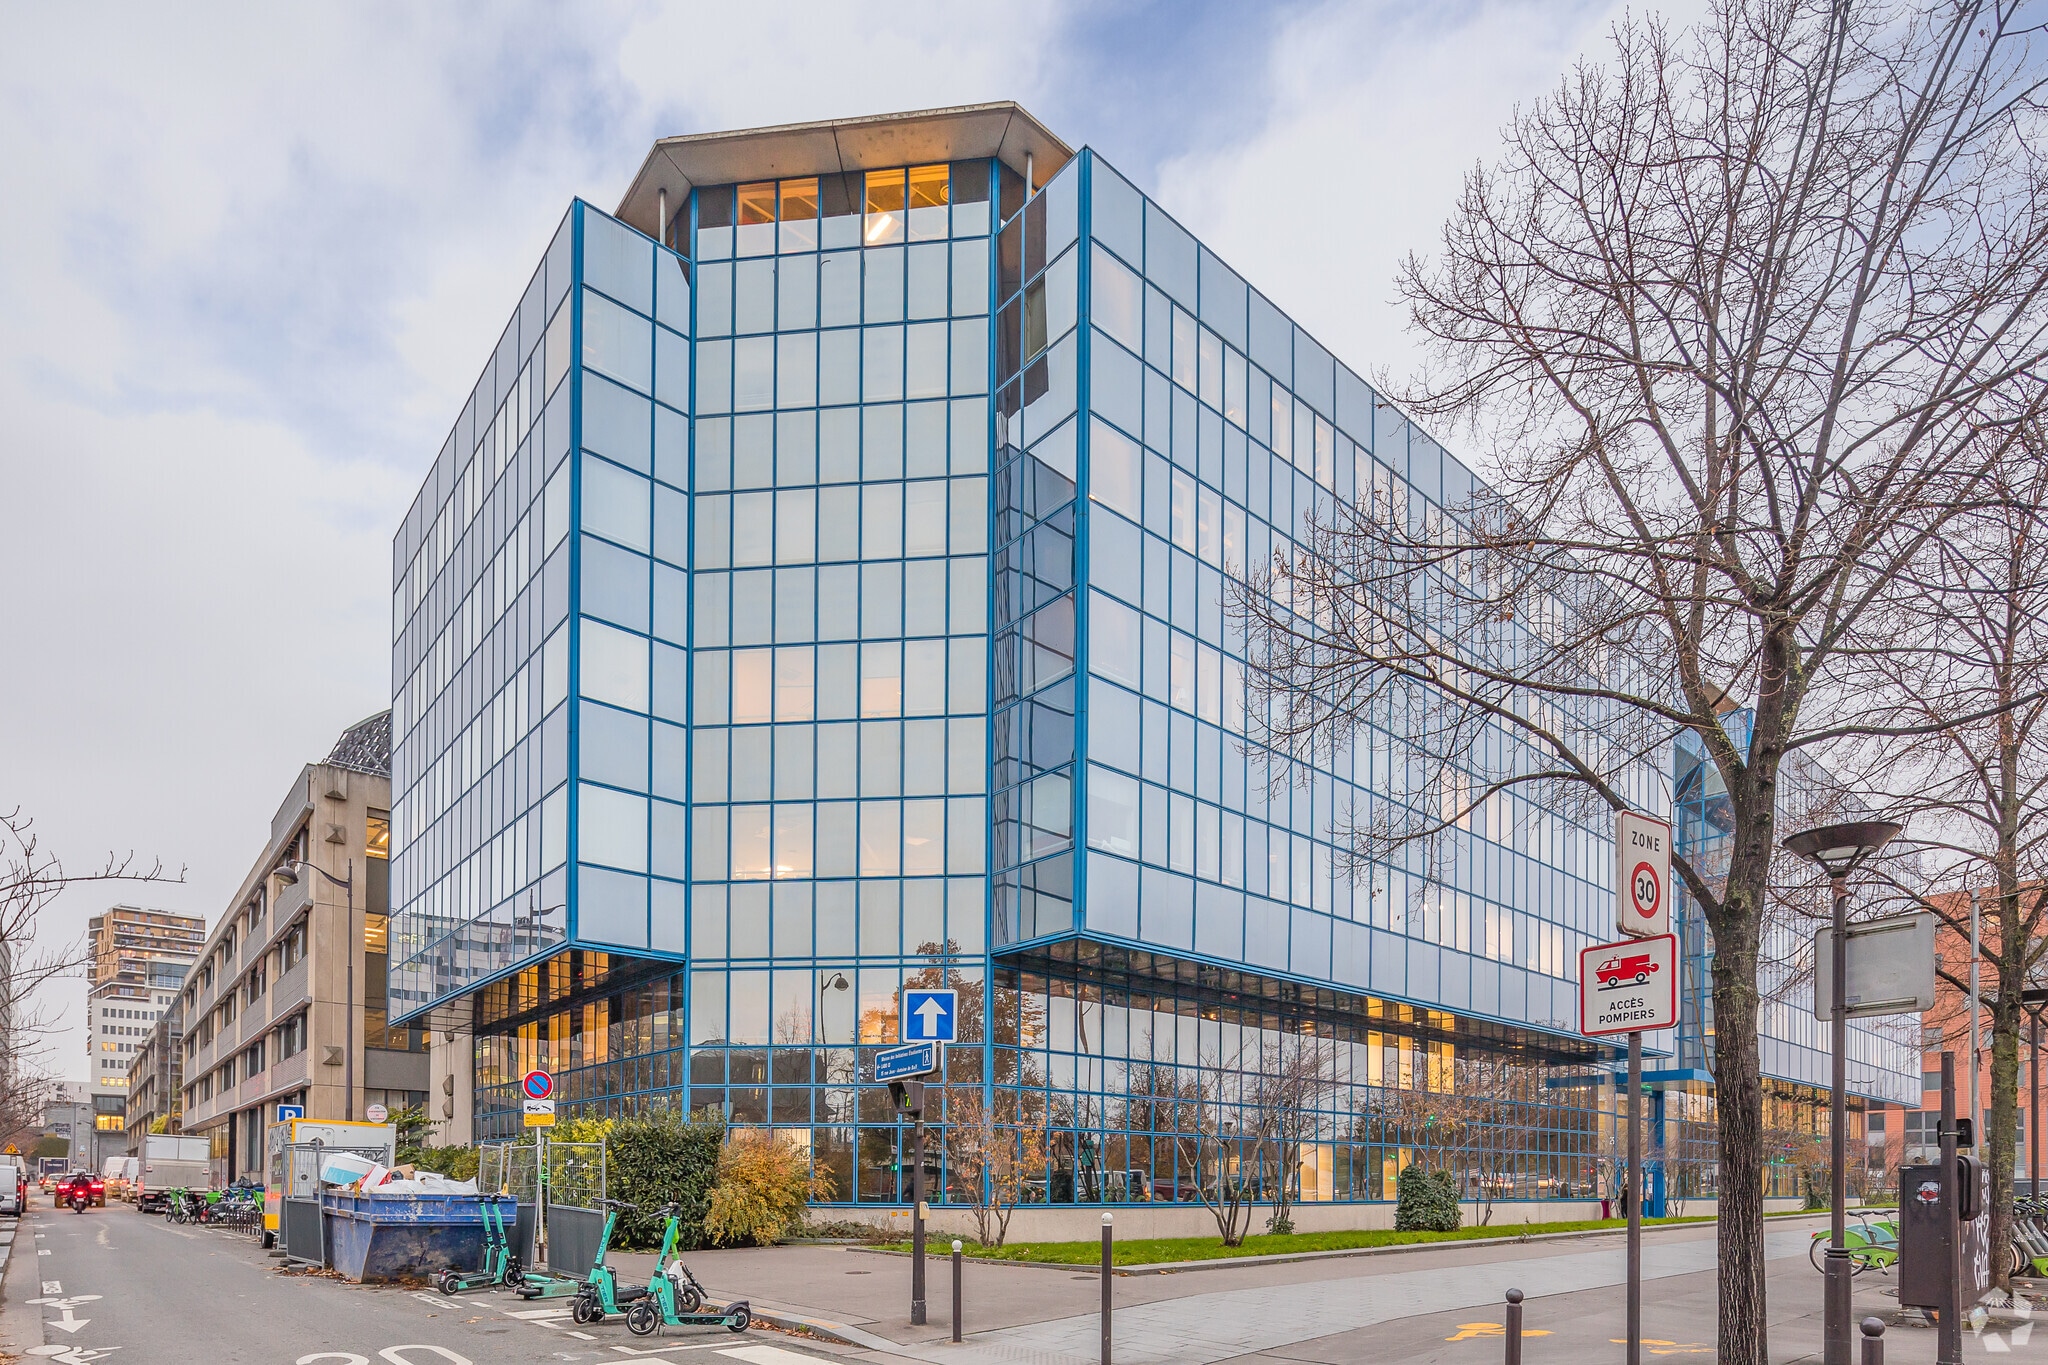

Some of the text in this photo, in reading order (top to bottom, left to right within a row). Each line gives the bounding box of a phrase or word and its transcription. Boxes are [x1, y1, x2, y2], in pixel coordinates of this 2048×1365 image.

[1632, 830, 1660, 852] ZONE
[1637, 877, 1655, 903] 30
[1609, 997, 1644, 1011] ACCÈS
[1599, 1008, 1655, 1024] POMPIERS
[285, 1109, 296, 1120] P
[660, 1295, 669, 1312] TIER
